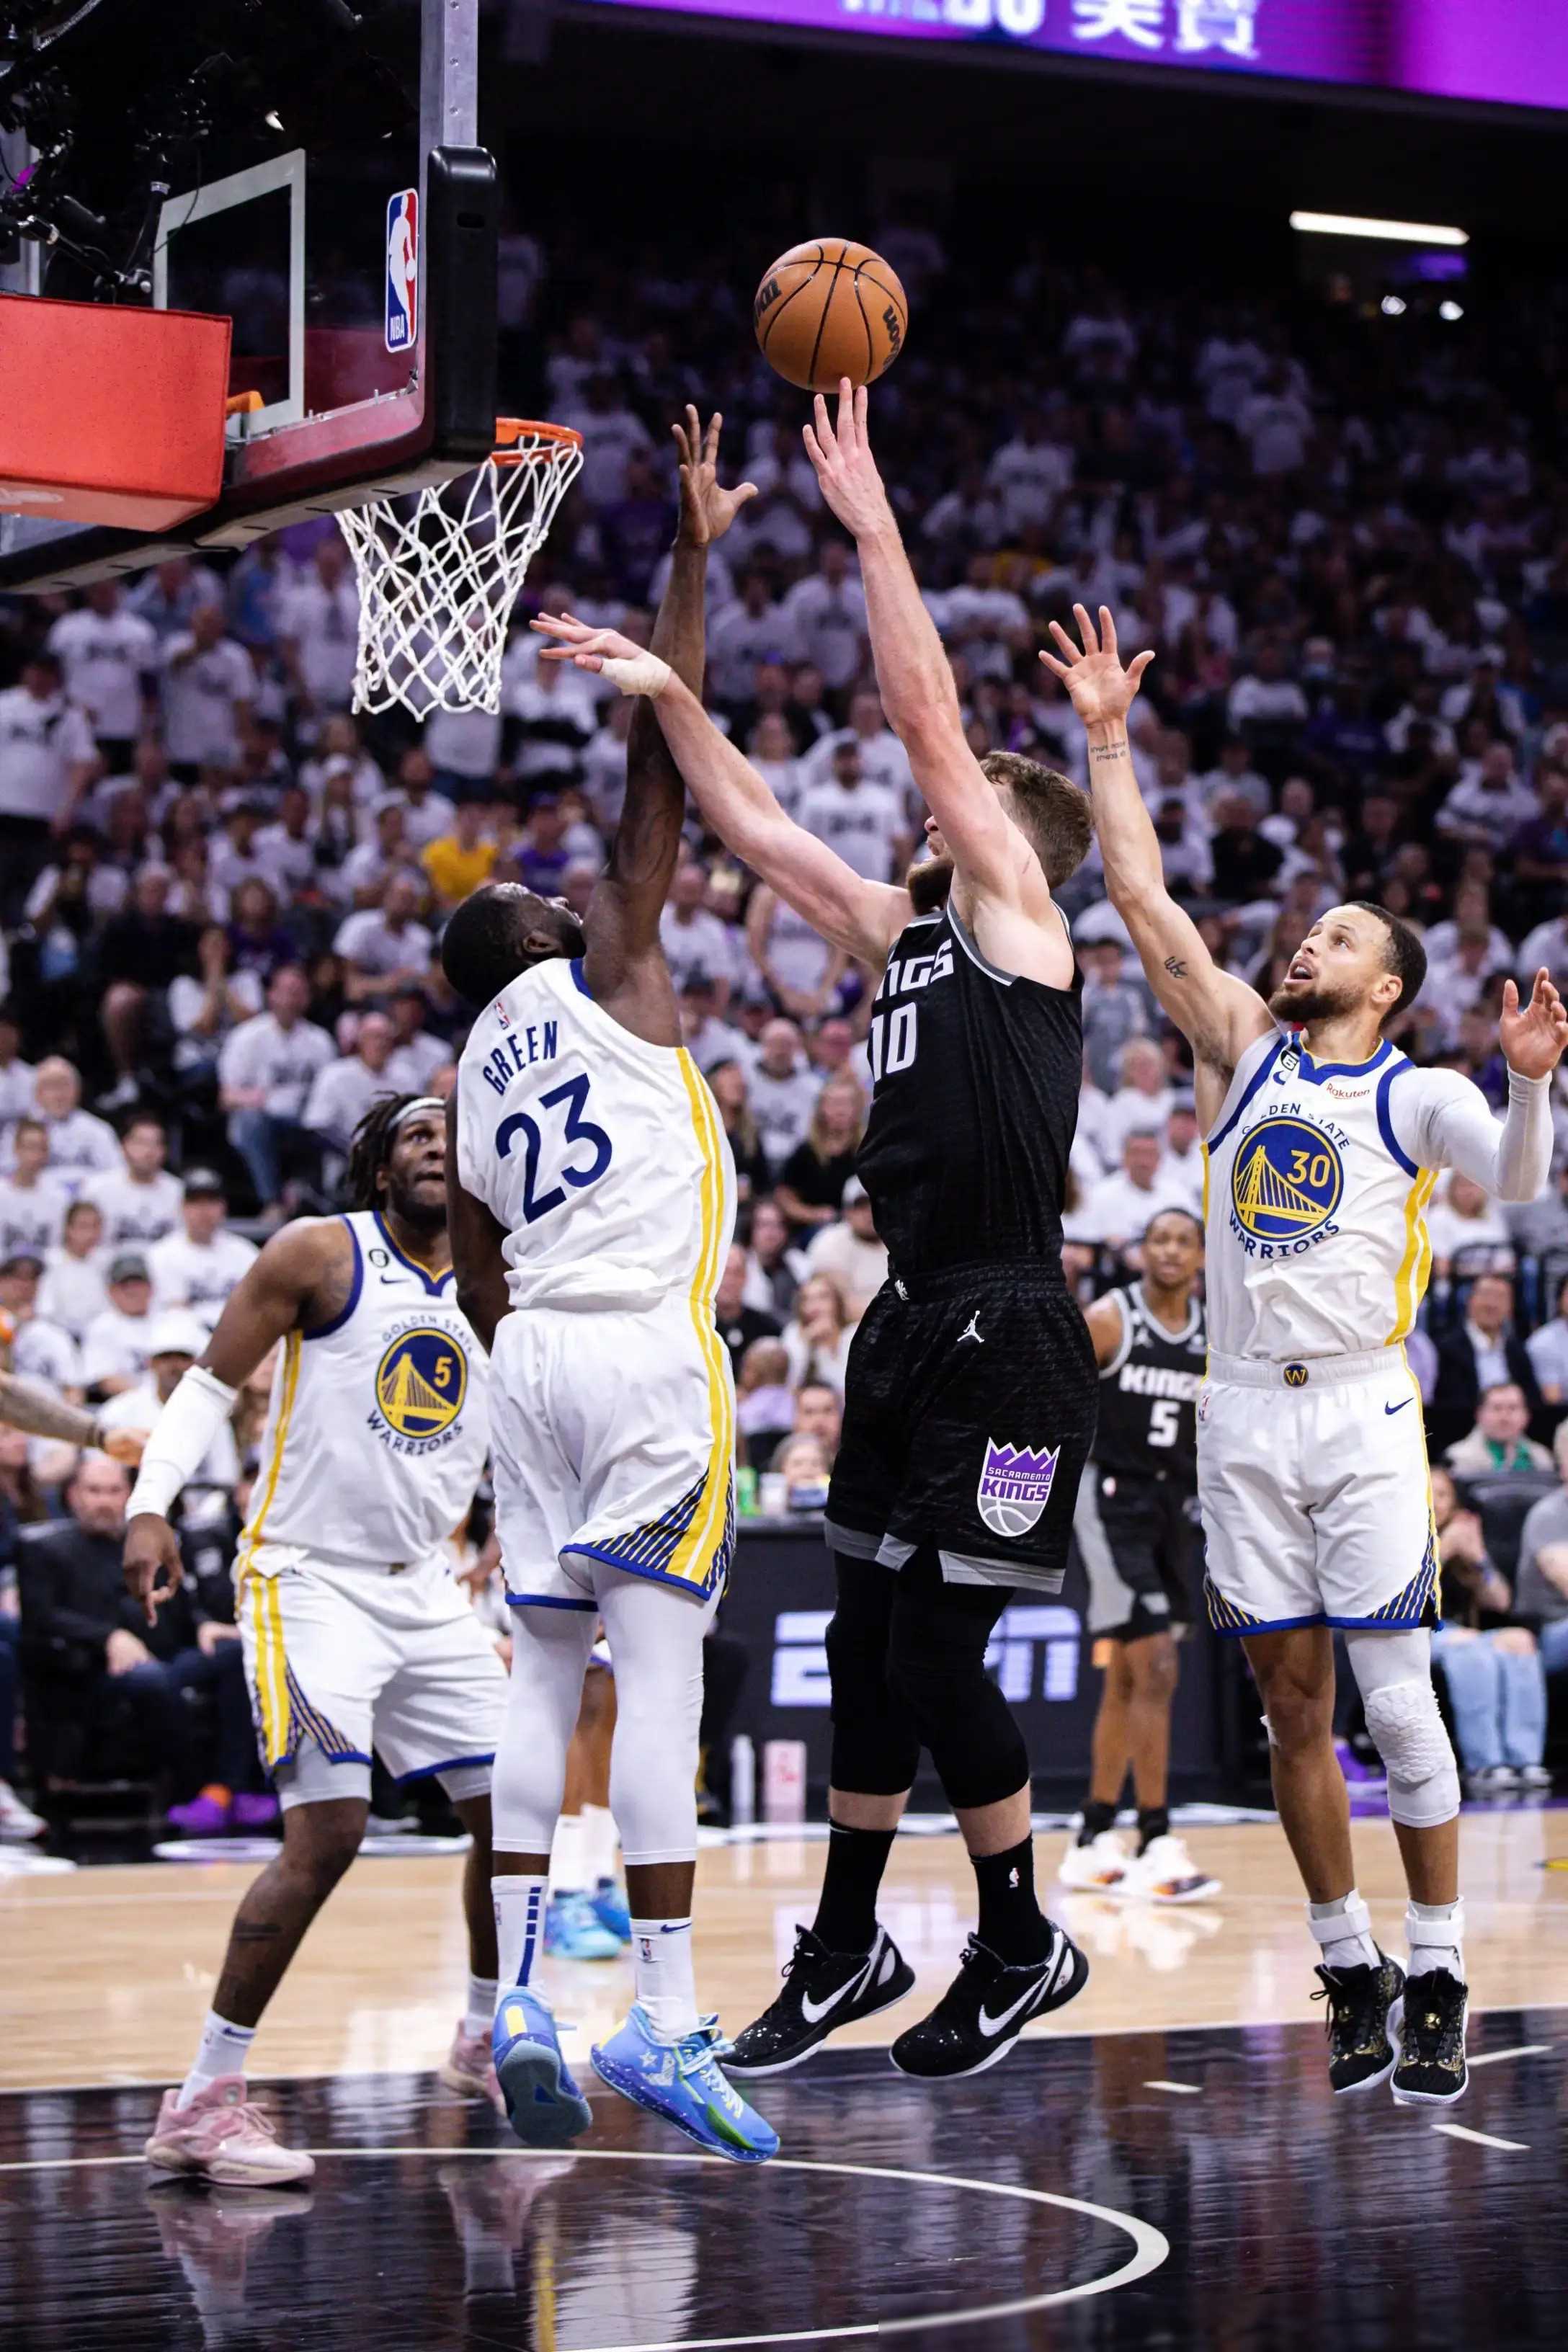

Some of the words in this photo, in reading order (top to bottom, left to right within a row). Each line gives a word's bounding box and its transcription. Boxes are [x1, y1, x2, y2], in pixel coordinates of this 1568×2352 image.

[390, 314, 405, 342] NBA
[875, 938, 954, 1001] NGS
[482, 1020, 558, 1096] GREEN
[870, 1002, 917, 1082] 10
[1327, 1082, 1371, 1099] Rakuten
[1242, 1102, 1301, 1135] GDEN
[495, 1073, 612, 1224] 23
[1286, 1149, 1331, 1188] 30
[1229, 1208, 1340, 1260] WARRIORS
[382, 1314, 437, 1343] GOLDEN
[434, 1355, 453, 1388] 5
[1285, 1368, 1307, 1385] W
[367, 1409, 463, 1456] WARRIORS
[1146, 1399, 1182, 1448] 5
[981, 1477, 1050, 1502] KINGS
[987, 1466, 1051, 1482] SACRAMENTO
